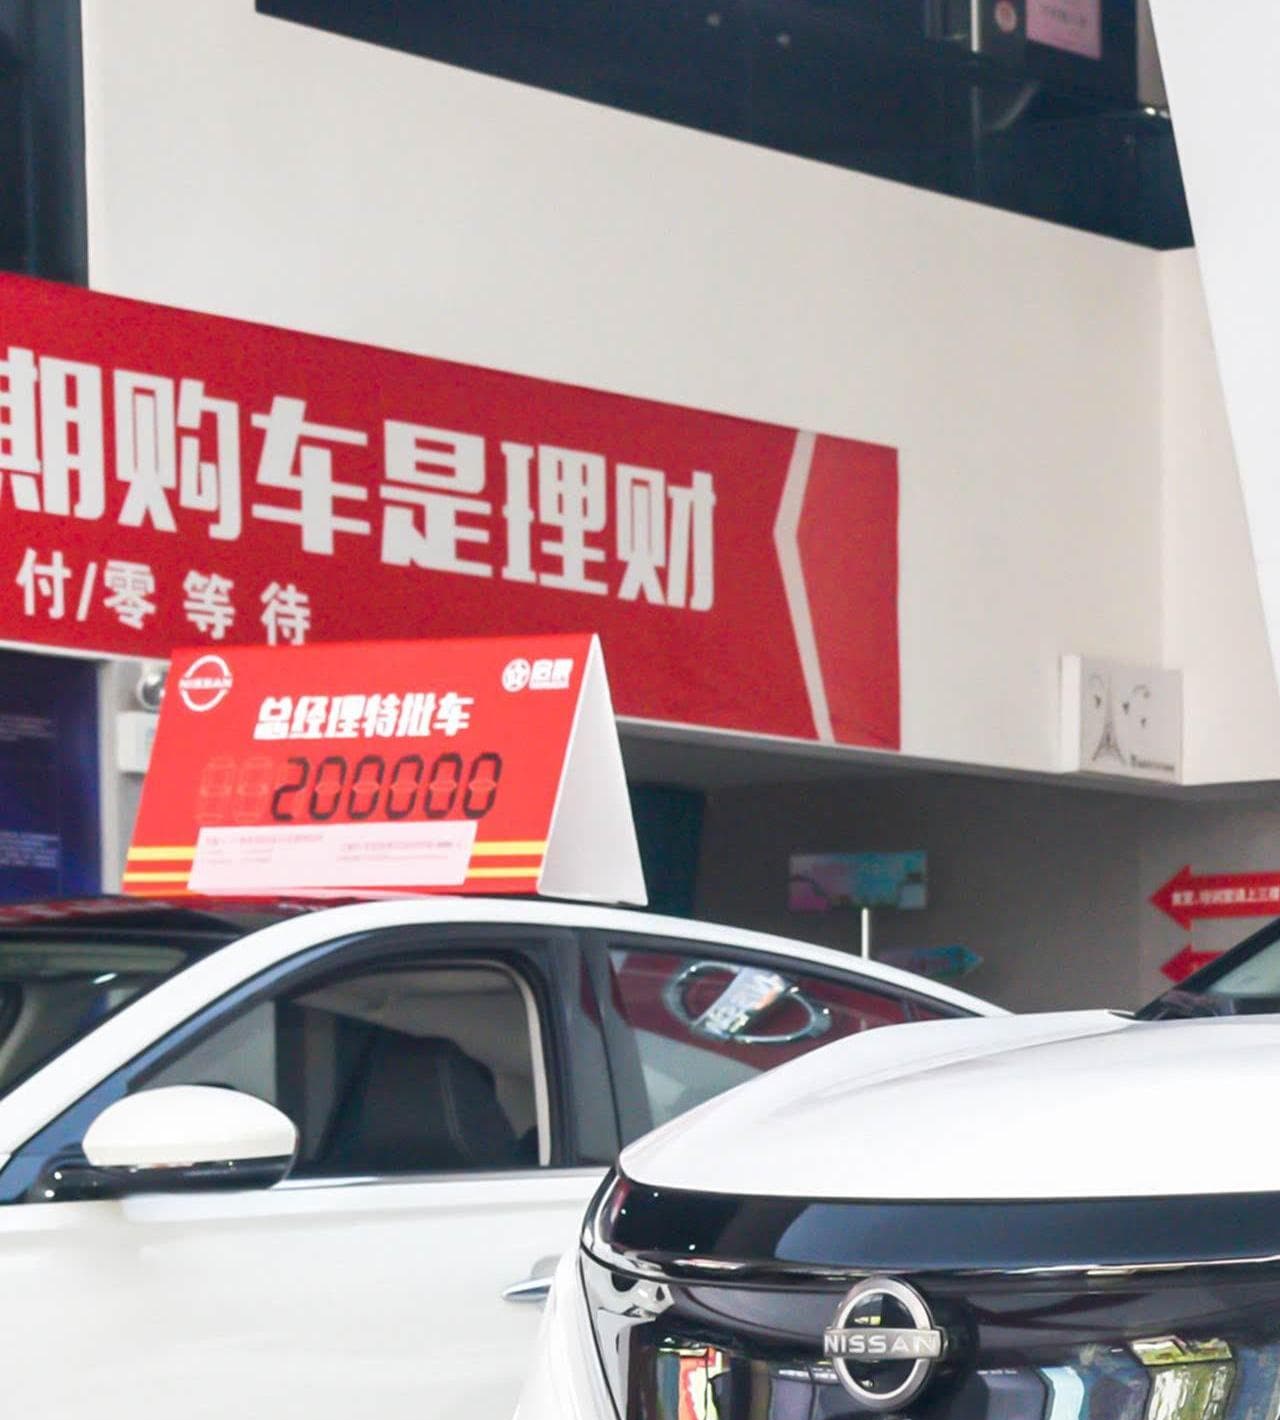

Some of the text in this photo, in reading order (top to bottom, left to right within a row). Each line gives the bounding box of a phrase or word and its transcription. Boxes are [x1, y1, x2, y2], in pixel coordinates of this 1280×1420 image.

[0, 346, 716, 612] 期购车是理财
[253, 692, 474, 740] 总经理特批车
[270, 752, 503, 821] 200000
[824, 1333, 937, 1354] NISSAN
